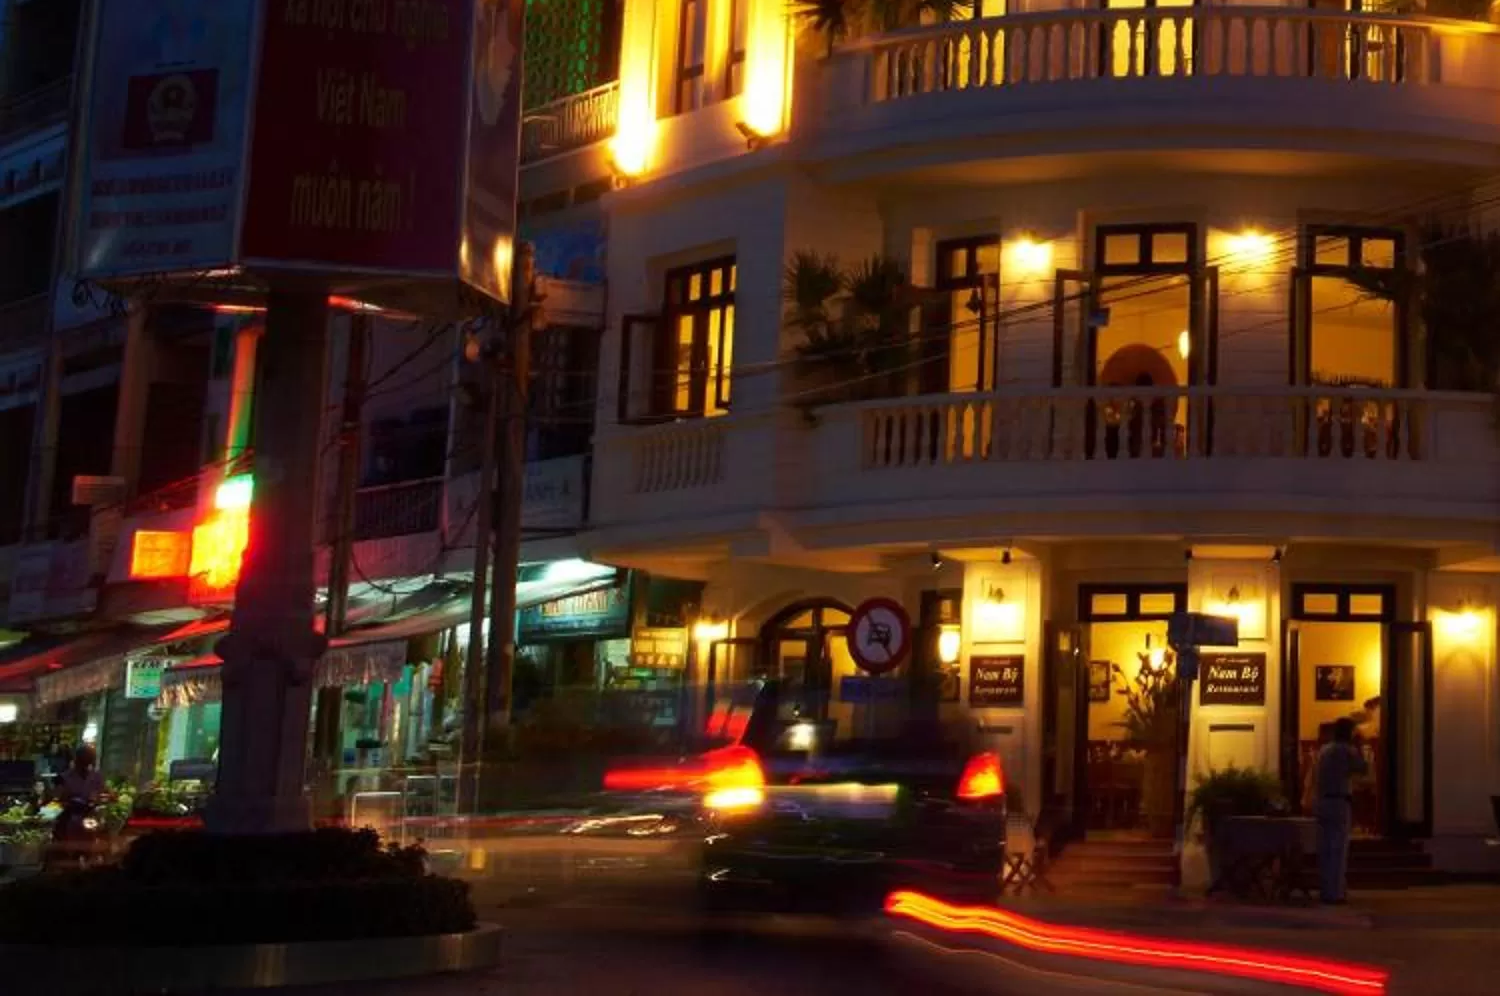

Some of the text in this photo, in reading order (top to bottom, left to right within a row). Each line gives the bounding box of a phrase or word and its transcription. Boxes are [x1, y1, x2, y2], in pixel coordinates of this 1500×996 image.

[316, 67, 408, 137] Việt Nam
[1207, 665, 1237, 681] Nam
